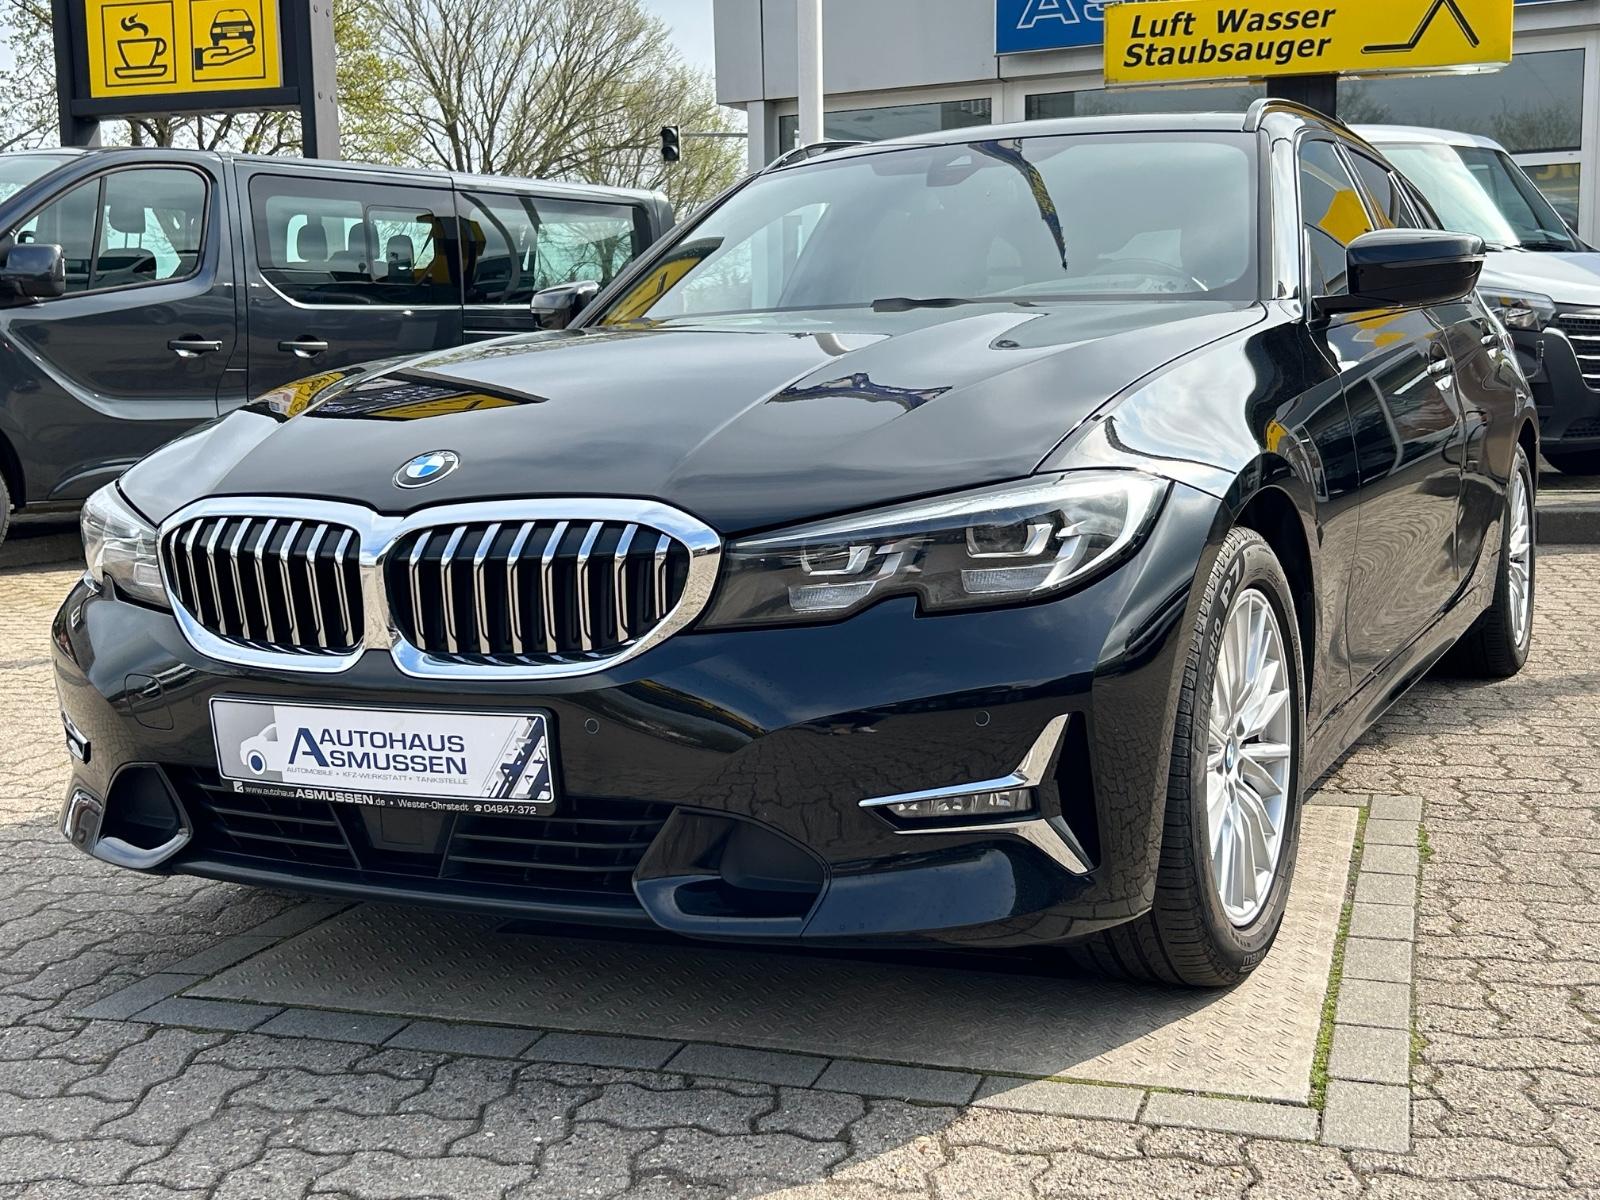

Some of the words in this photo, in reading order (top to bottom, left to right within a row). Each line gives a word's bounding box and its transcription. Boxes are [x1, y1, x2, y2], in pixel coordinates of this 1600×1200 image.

[1130, 11, 1197, 39] Luft
[1216, 8, 1336, 34] Wasser
[1123, 38, 1332, 68] Staubsauger
[1219, 559, 1241, 609] P7
[288, 727, 468, 775] ASMUSSEN
[319, 728, 466, 753] AUTOHAUS
[286, 766, 334, 777] AUTOMOBILE
[342, 771, 408, 782] KFZ-WERKSTATT
[415, 775, 469, 786] TANKSTELLE
[397, 798, 470, 812] Wester-Ohrstedt
[483, 803, 537, 816] 04847-372
